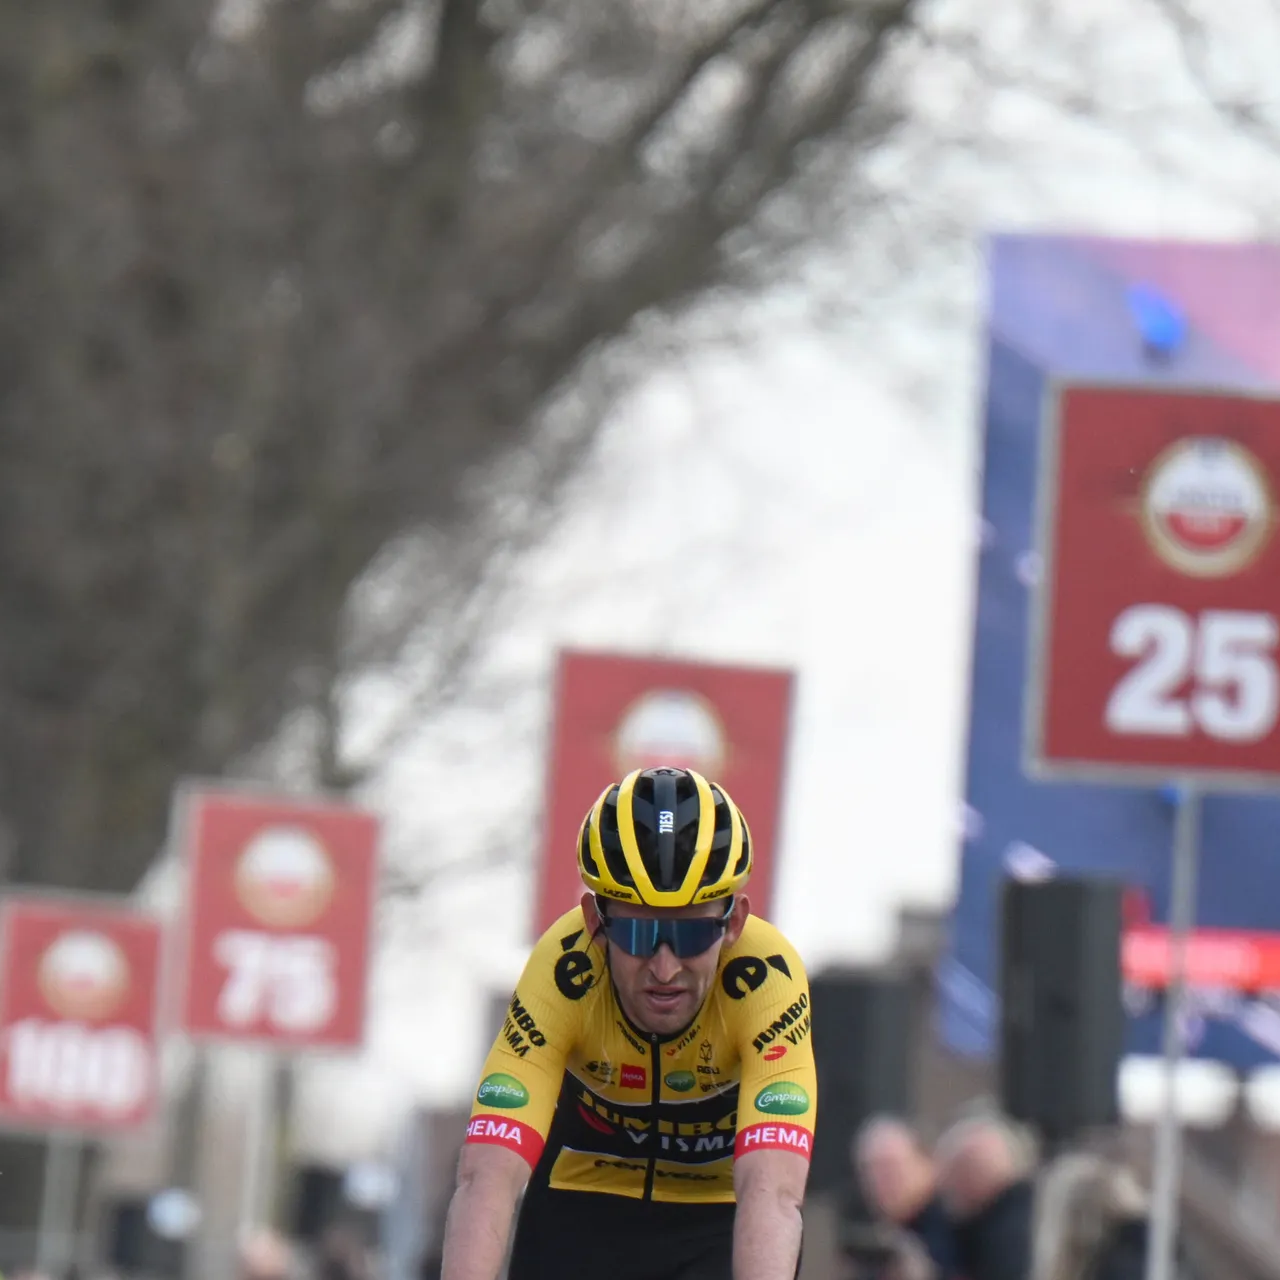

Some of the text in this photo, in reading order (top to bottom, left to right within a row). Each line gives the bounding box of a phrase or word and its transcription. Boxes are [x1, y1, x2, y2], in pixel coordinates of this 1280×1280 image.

[603, 887, 633, 900] LAZER
[211, 928, 339, 1033] 75
[752, 992, 809, 1054] JUMBO
[784, 1012, 812, 1046] VISM
[467, 1120, 522, 1145] HEMA
[743, 1126, 810, 1153] HEMA
